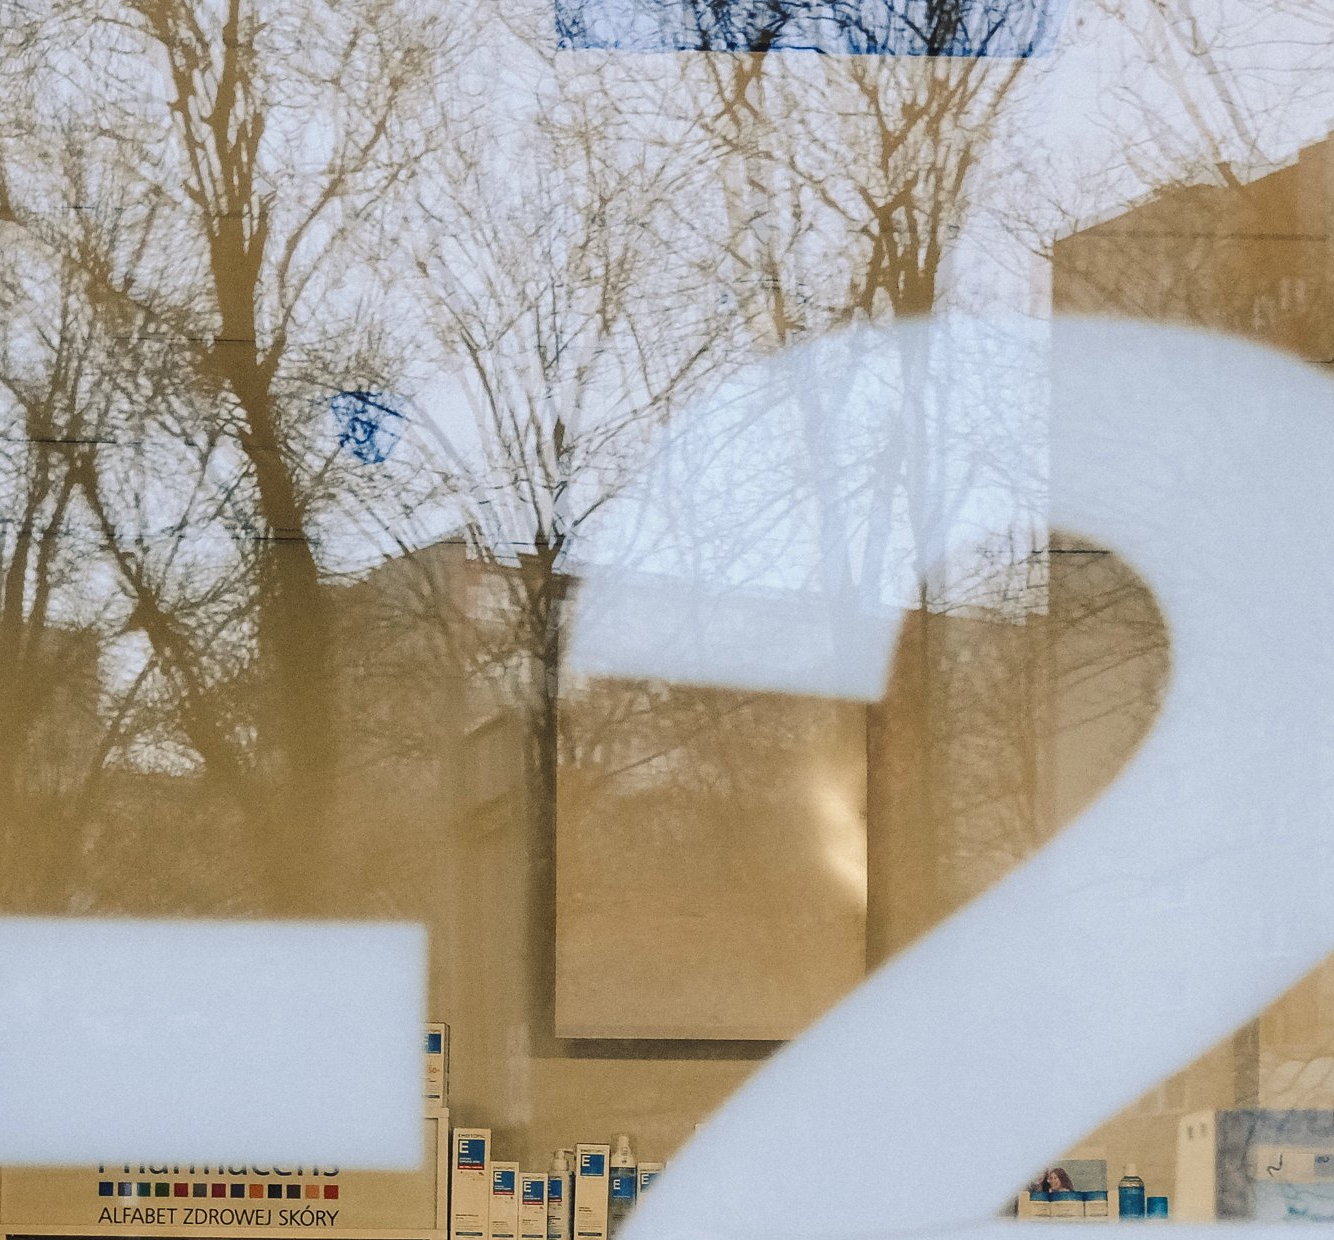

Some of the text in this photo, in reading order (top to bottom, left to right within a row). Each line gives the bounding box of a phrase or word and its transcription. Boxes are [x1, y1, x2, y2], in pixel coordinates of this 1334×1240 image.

[459, 1141, 469, 1154] E
[582, 1155, 590, 1166] E
[494, 1172, 502, 1182] E
[642, 1174, 649, 1184] E
[523, 1182, 531, 1192] E
[613, 1179, 620, 1190] E
[98, 1205, 339, 1226] ALFABET ZDROWEJ SKÓRY
